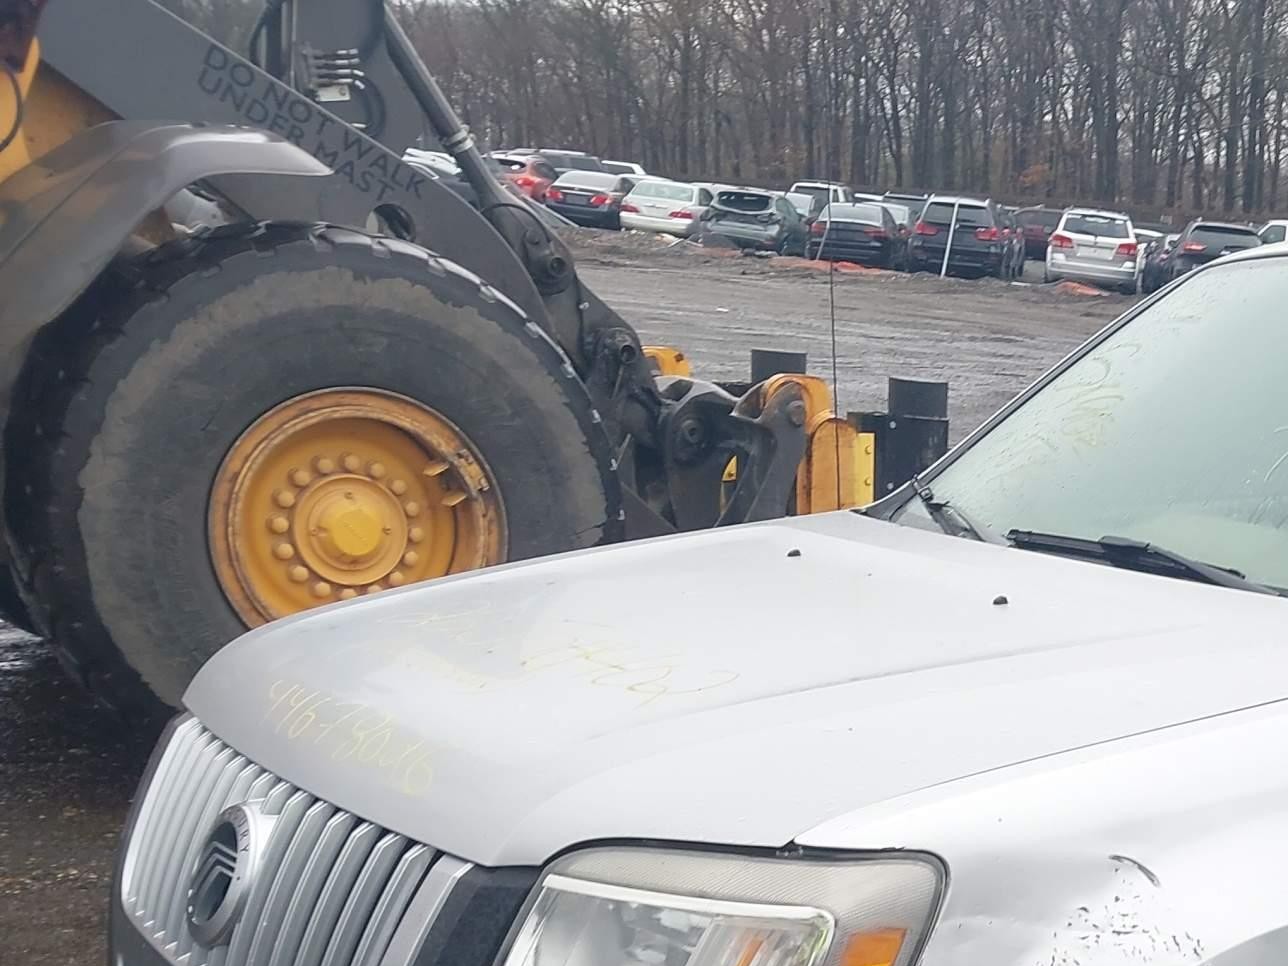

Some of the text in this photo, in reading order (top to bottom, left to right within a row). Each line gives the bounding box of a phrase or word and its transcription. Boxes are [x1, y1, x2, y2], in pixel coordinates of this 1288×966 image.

[197, 65, 395, 201] UNDER MAST
[203, 45, 427, 200] DO NOT WALK
